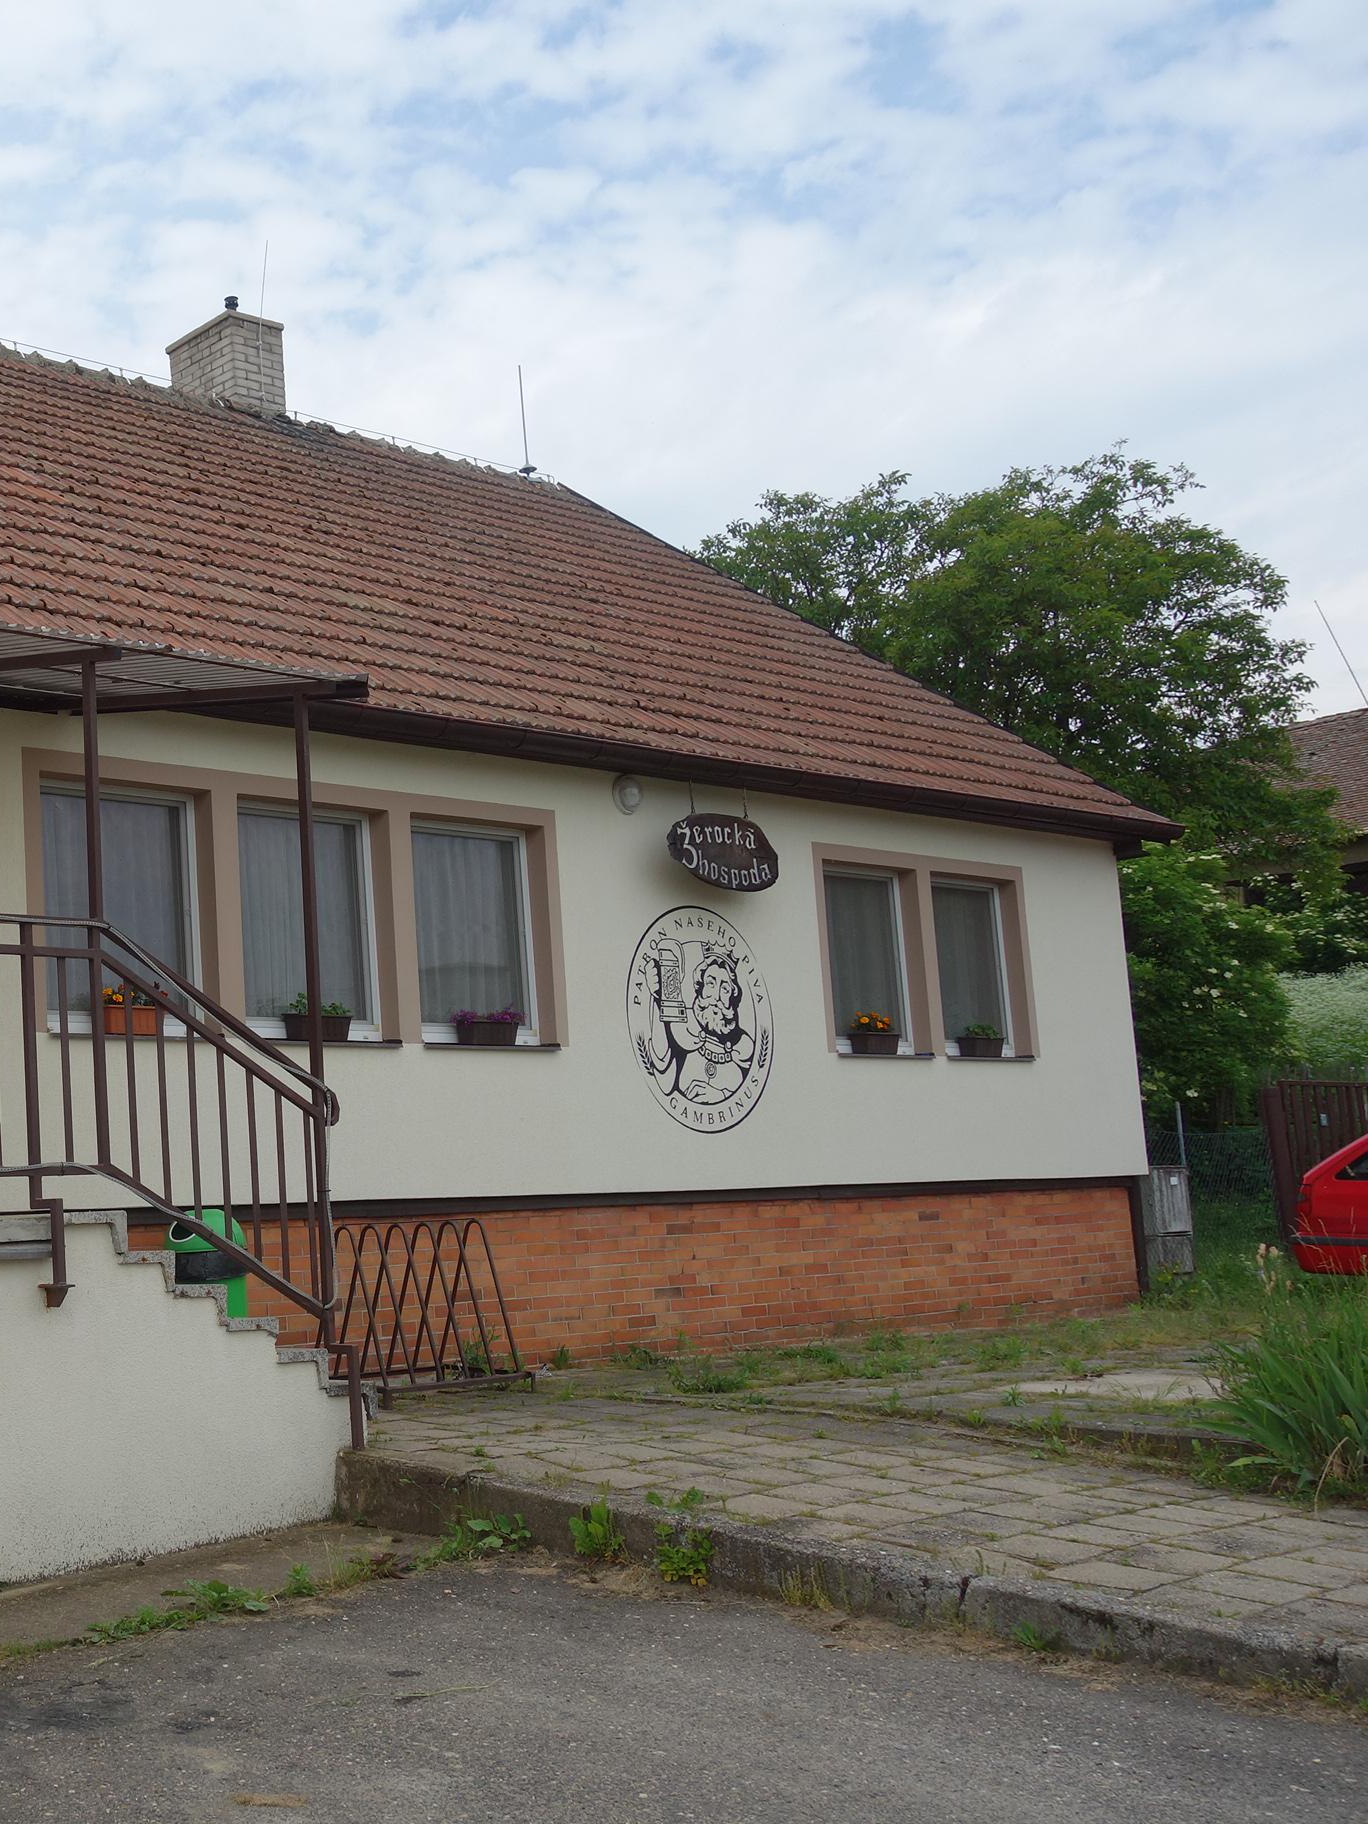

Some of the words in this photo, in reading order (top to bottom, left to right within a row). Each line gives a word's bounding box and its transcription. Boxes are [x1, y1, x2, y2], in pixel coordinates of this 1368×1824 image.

[698, 849, 772, 889] hospoda
[633, 927, 668, 1006] PATRON
[741, 954, 764, 1004] PIVA
[669, 1075, 760, 1125] GAMBRINUS
